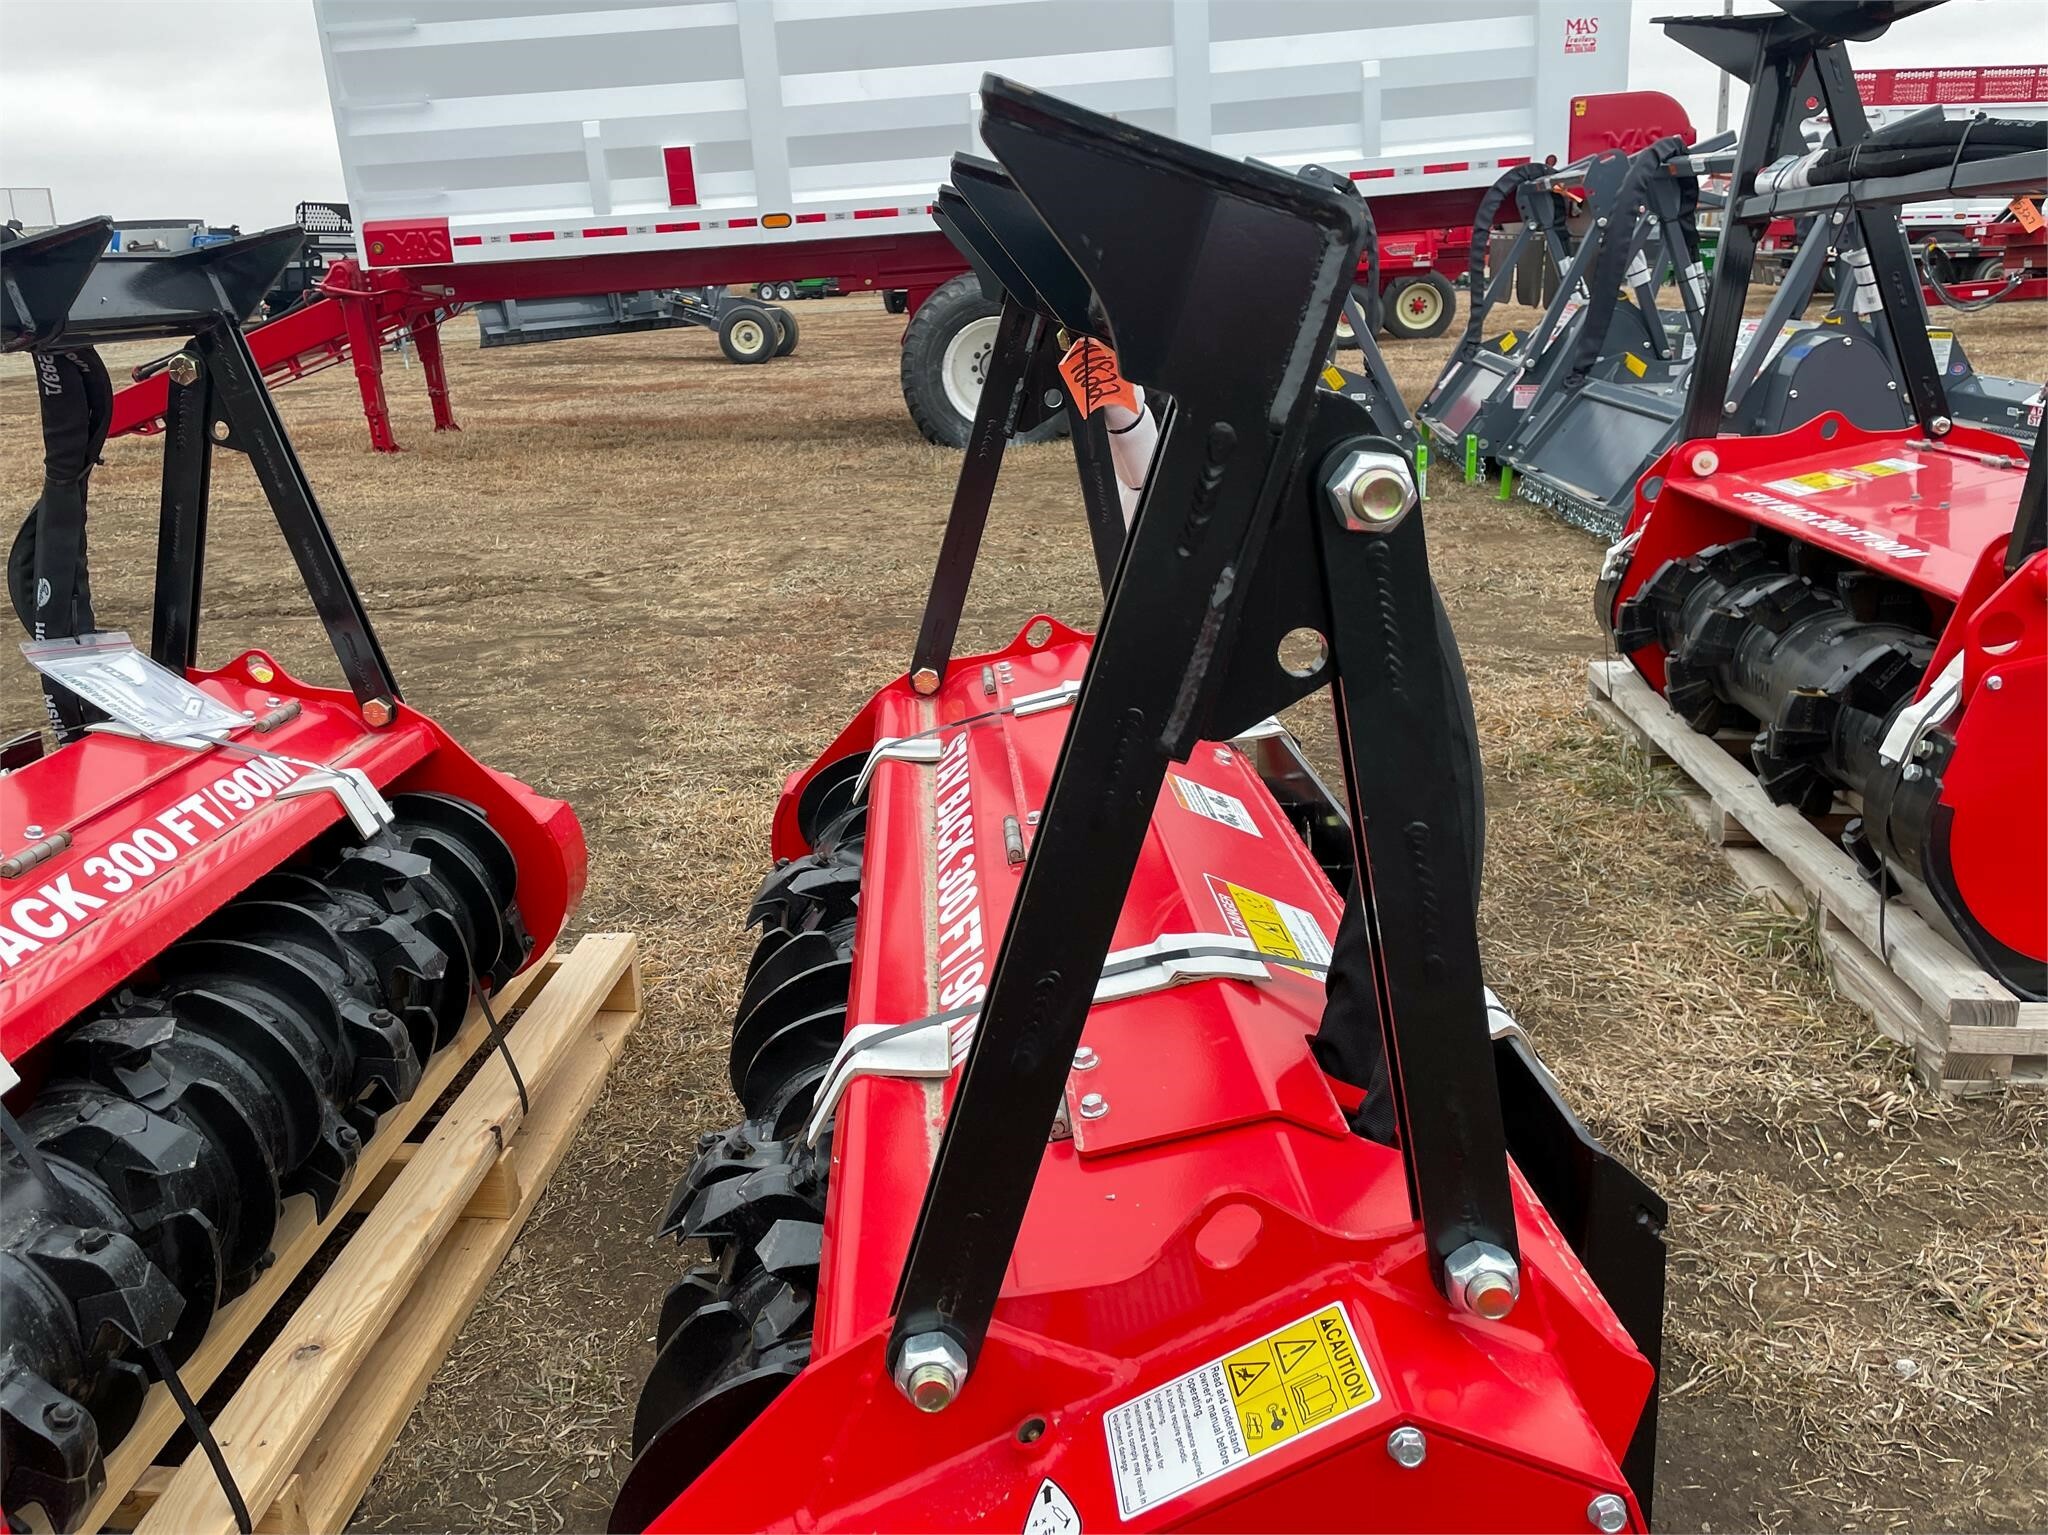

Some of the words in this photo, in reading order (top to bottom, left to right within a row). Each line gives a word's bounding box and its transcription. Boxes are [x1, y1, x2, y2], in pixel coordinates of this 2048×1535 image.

[1566, 17, 1599, 35] MAS
[386, 230, 447, 260] MAS
[45, 694, 68, 740] MSHA
[936, 731, 970, 799] STAY
[937, 781, 974, 871] BACK
[0, 872, 109, 973] ACK
[82, 827, 179, 894] 300
[155, 755, 299, 847] FT/90M
[938, 853, 979, 926] 300
[1210, 1365, 1223, 1387] Read
[1324, 1326, 1367, 1400] CAUTION
[1167, 1397, 1176, 1413] bolts
[1185, 1377, 1204, 1419] operating.
[1216, 1387, 1227, 1404] and
[1111, 1413, 1123, 1446] equipment
[1123, 1407, 1132, 1429] Failure
[1133, 1403, 1146, 1442] maintenance
[1146, 1410, 1156, 1435] owner's
[1152, 1435, 1162, 1459] manual
[1170, 1414, 1181, 1437] require
[1175, 1383, 1187, 1408] Periodic
[1181, 1408, 1196, 1448] maintenance
[1190, 1448, 1203, 1478] required.
[1198, 1371, 1214, 1403] owner's
[1207, 1403, 1223, 1436] manual
[1216, 1435, 1231, 1465] before
[1221, 1404, 1242, 1454] understand
[1127, 1437, 1138, 1461] comply
[1176, 1436, 1187, 1463] periodic
[1132, 1461, 1140, 1476] may
[1136, 1475, 1145, 1496] result
[1140, 1496, 1147, 1504] in
